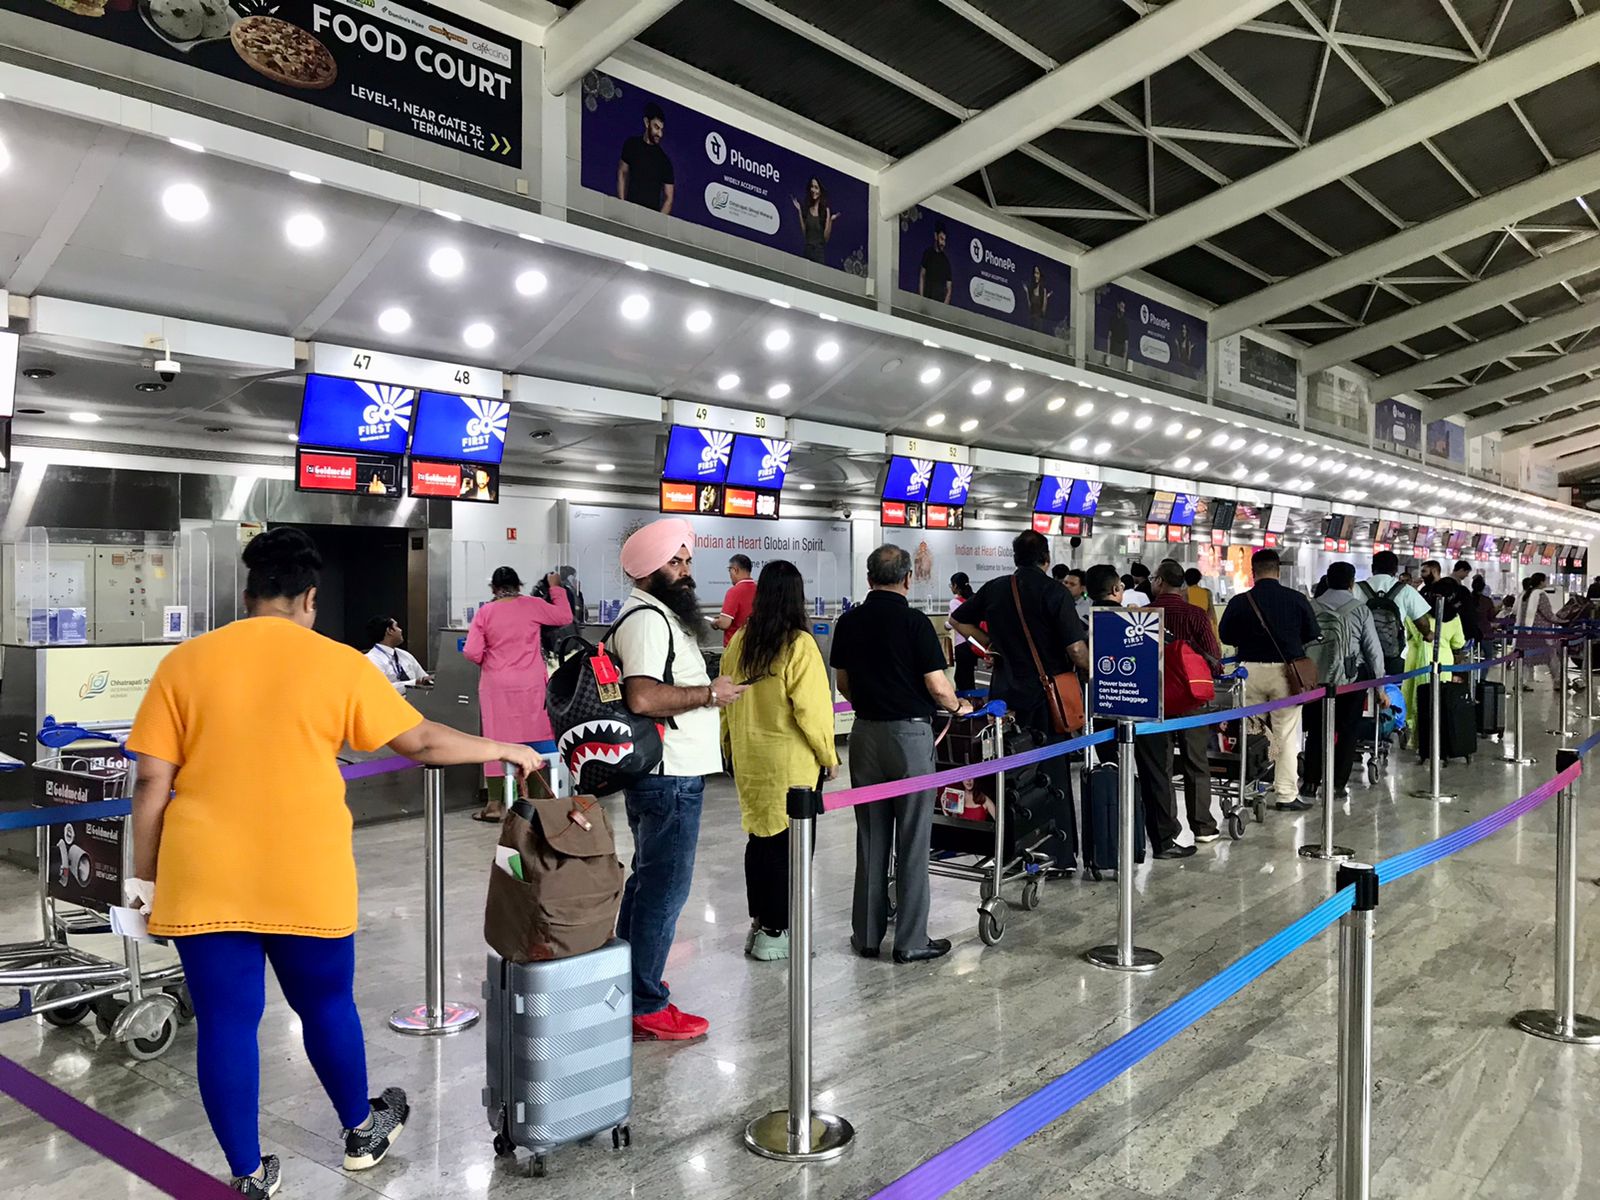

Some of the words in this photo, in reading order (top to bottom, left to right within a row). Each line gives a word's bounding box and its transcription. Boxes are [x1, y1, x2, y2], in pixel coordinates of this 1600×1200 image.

[313, 3, 407, 62] FOOD
[414, 45, 512, 100] COURT
[351, 84, 401, 112] LEVEL-1,
[403, 101, 436, 122] NEAR
[438, 113, 468, 132] GATE
[469, 126, 486, 139] 25,
[411, 117, 471, 146] TERMINAL
[472, 138, 486, 151] 1C
[730, 148, 780, 183] PhonePe
[985, 249, 1016, 273] PhonePe
[353, 354, 371, 370] 47
[454, 369, 471, 385] 48
[362, 402, 396, 425] GO
[696, 408, 707, 420] 49
[358, 422, 392, 437] FIRST
[465, 416, 495, 437] GO
[755, 416, 765, 429] 50
[461, 434, 491, 448] FIRST
[909, 440, 917, 451] 51
[701, 445, 720, 462] GO
[949, 447, 957, 458] 52
[697, 459, 718, 471] FIRST
[761, 453, 779, 469] GO
[314, 465, 352, 476] Goldmedal
[757, 466, 777, 478] FIRST
[423, 473, 458, 484] Goldmedal
[694, 533, 724, 549] Indian
[726, 536, 736, 549] at
[738, 535, 762, 550] Heart
[763, 536, 790, 551] Global
[792, 537, 800, 551] in
[997, 545, 1015, 557] Globa
[1125, 624, 1145, 638] GO
[1123, 635, 1144, 645] FIRST
[110, 679, 142, 687] Chhatrapati
[1122, 695, 1148, 704] baggage
[53, 782, 88, 802] Goldmedal
[92, 824, 119, 841] Goldmedal
